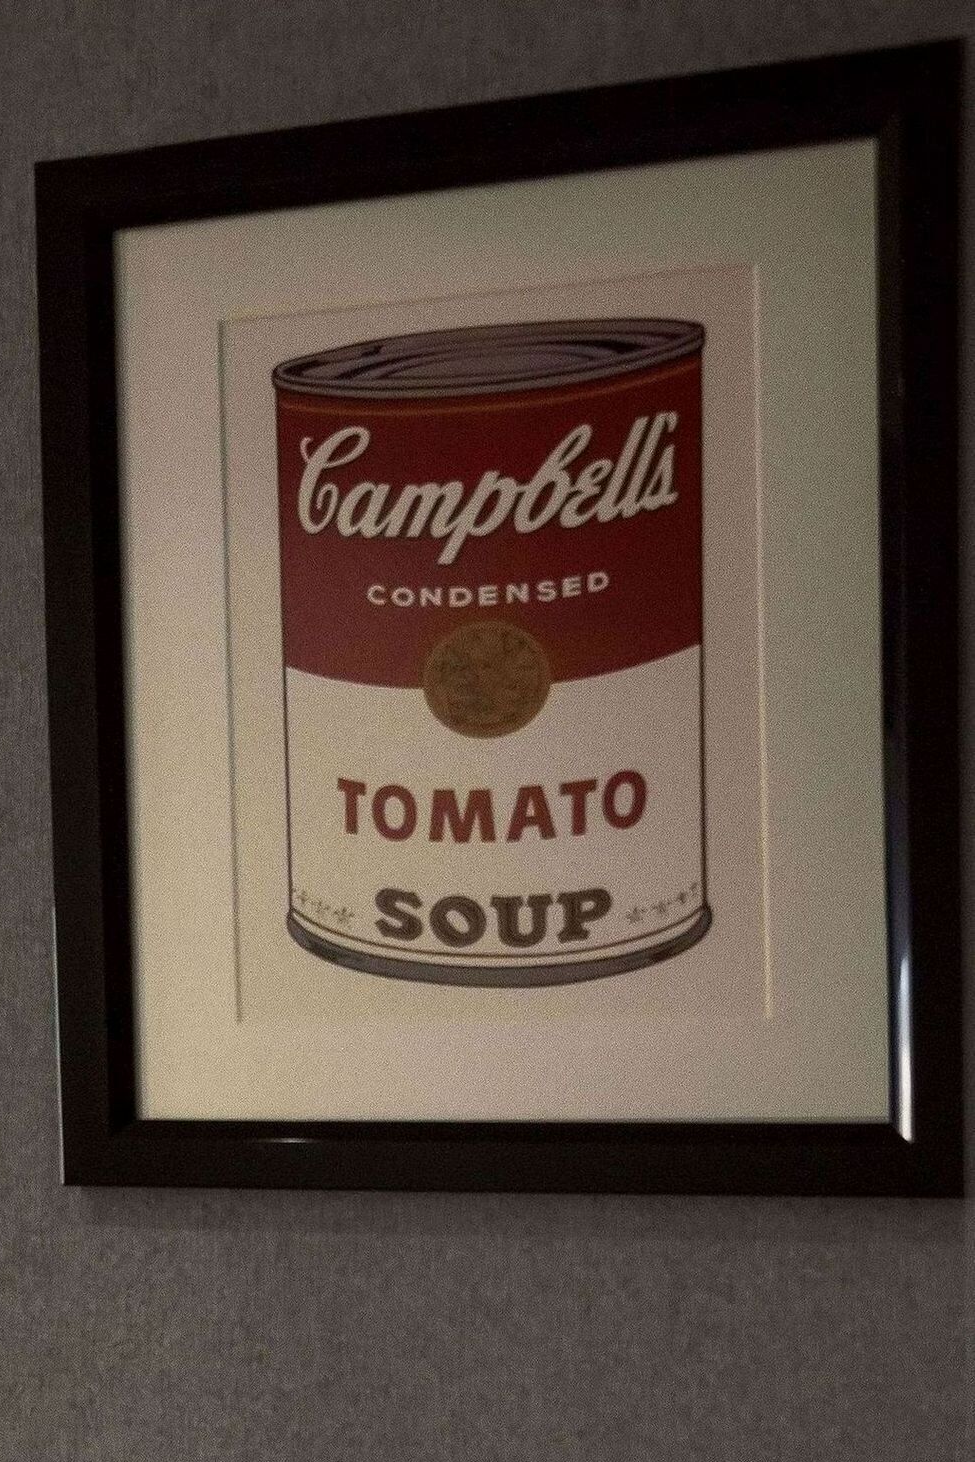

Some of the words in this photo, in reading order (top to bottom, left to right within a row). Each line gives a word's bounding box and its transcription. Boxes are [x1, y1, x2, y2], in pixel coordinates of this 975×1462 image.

[367, 571, 610, 607] CONDENSED
[337, 769, 649, 843] TOMATO
[374, 887, 613, 948] SOUP
